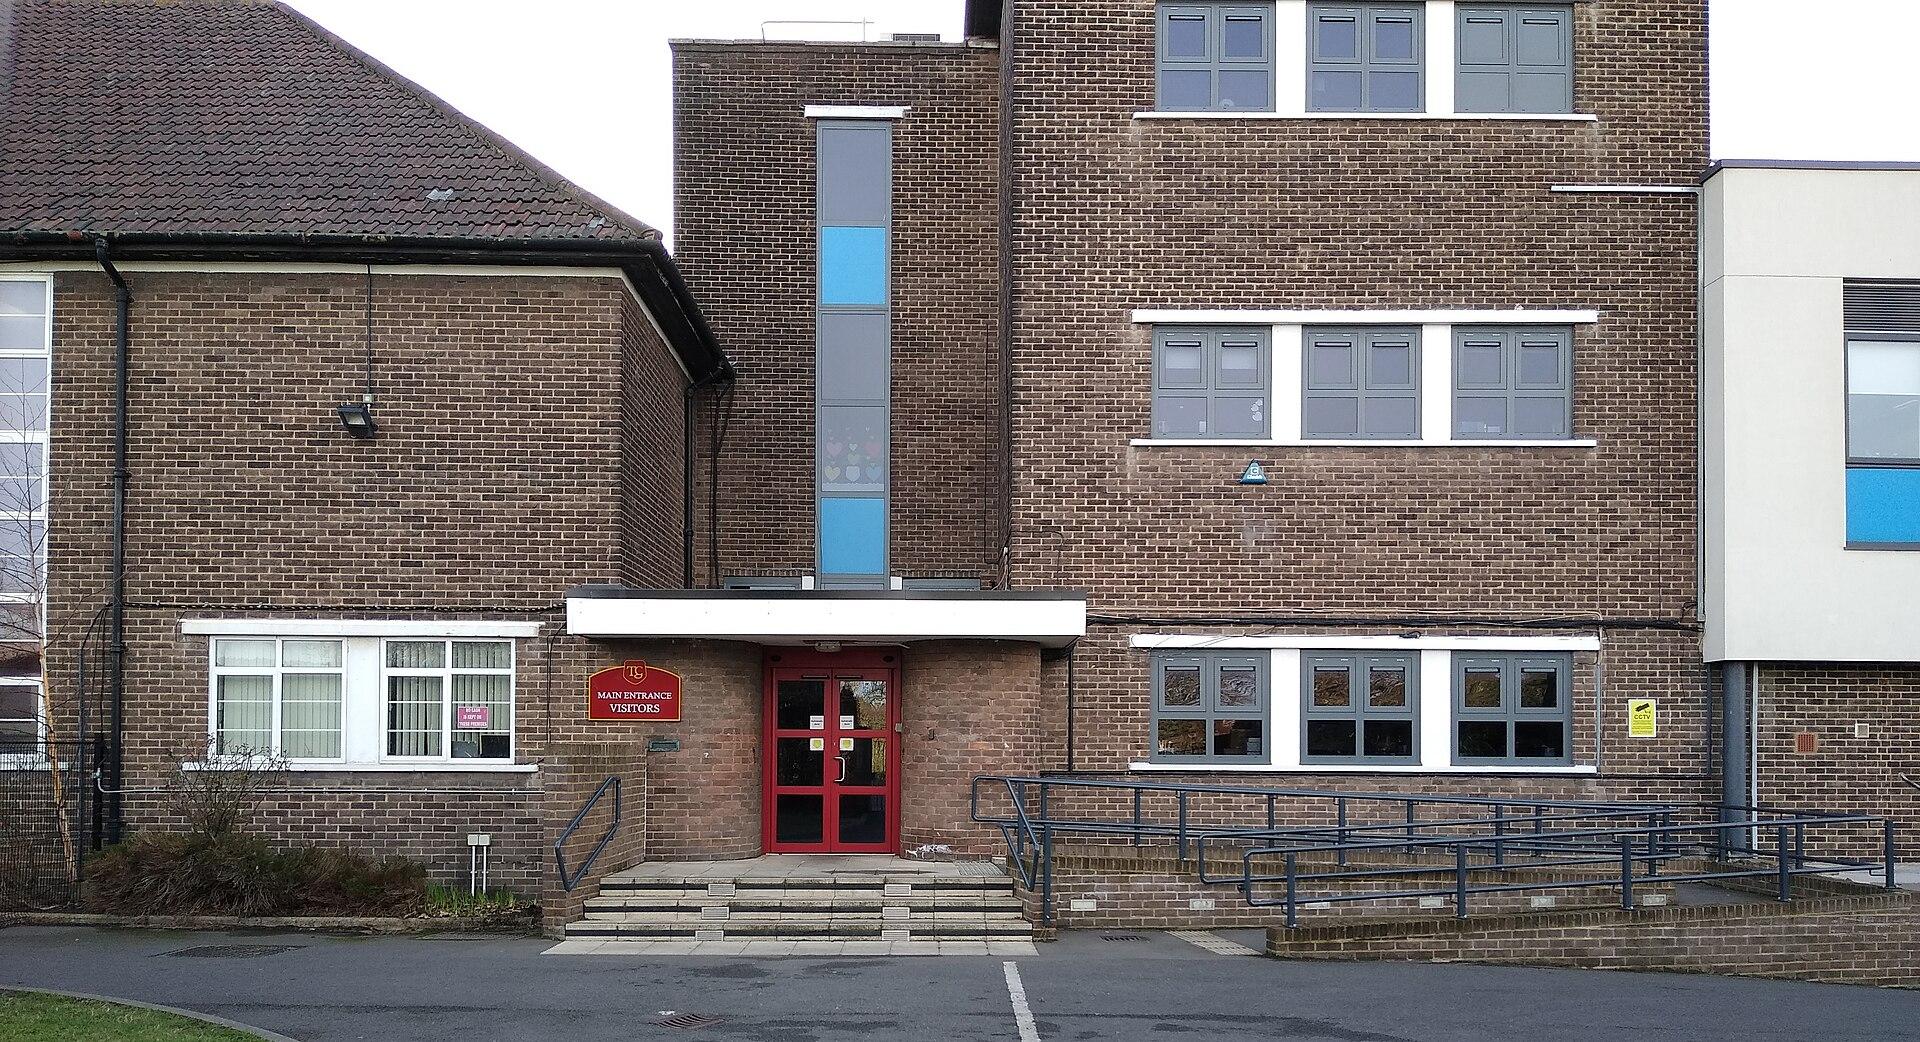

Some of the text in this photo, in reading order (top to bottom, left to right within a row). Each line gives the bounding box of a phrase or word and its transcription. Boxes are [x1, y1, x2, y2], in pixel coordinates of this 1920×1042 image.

[626, 665, 644, 679] TG
[597, 691, 673, 700] MAIN ENTRANCE
[610, 703, 660, 713] VISITORS
